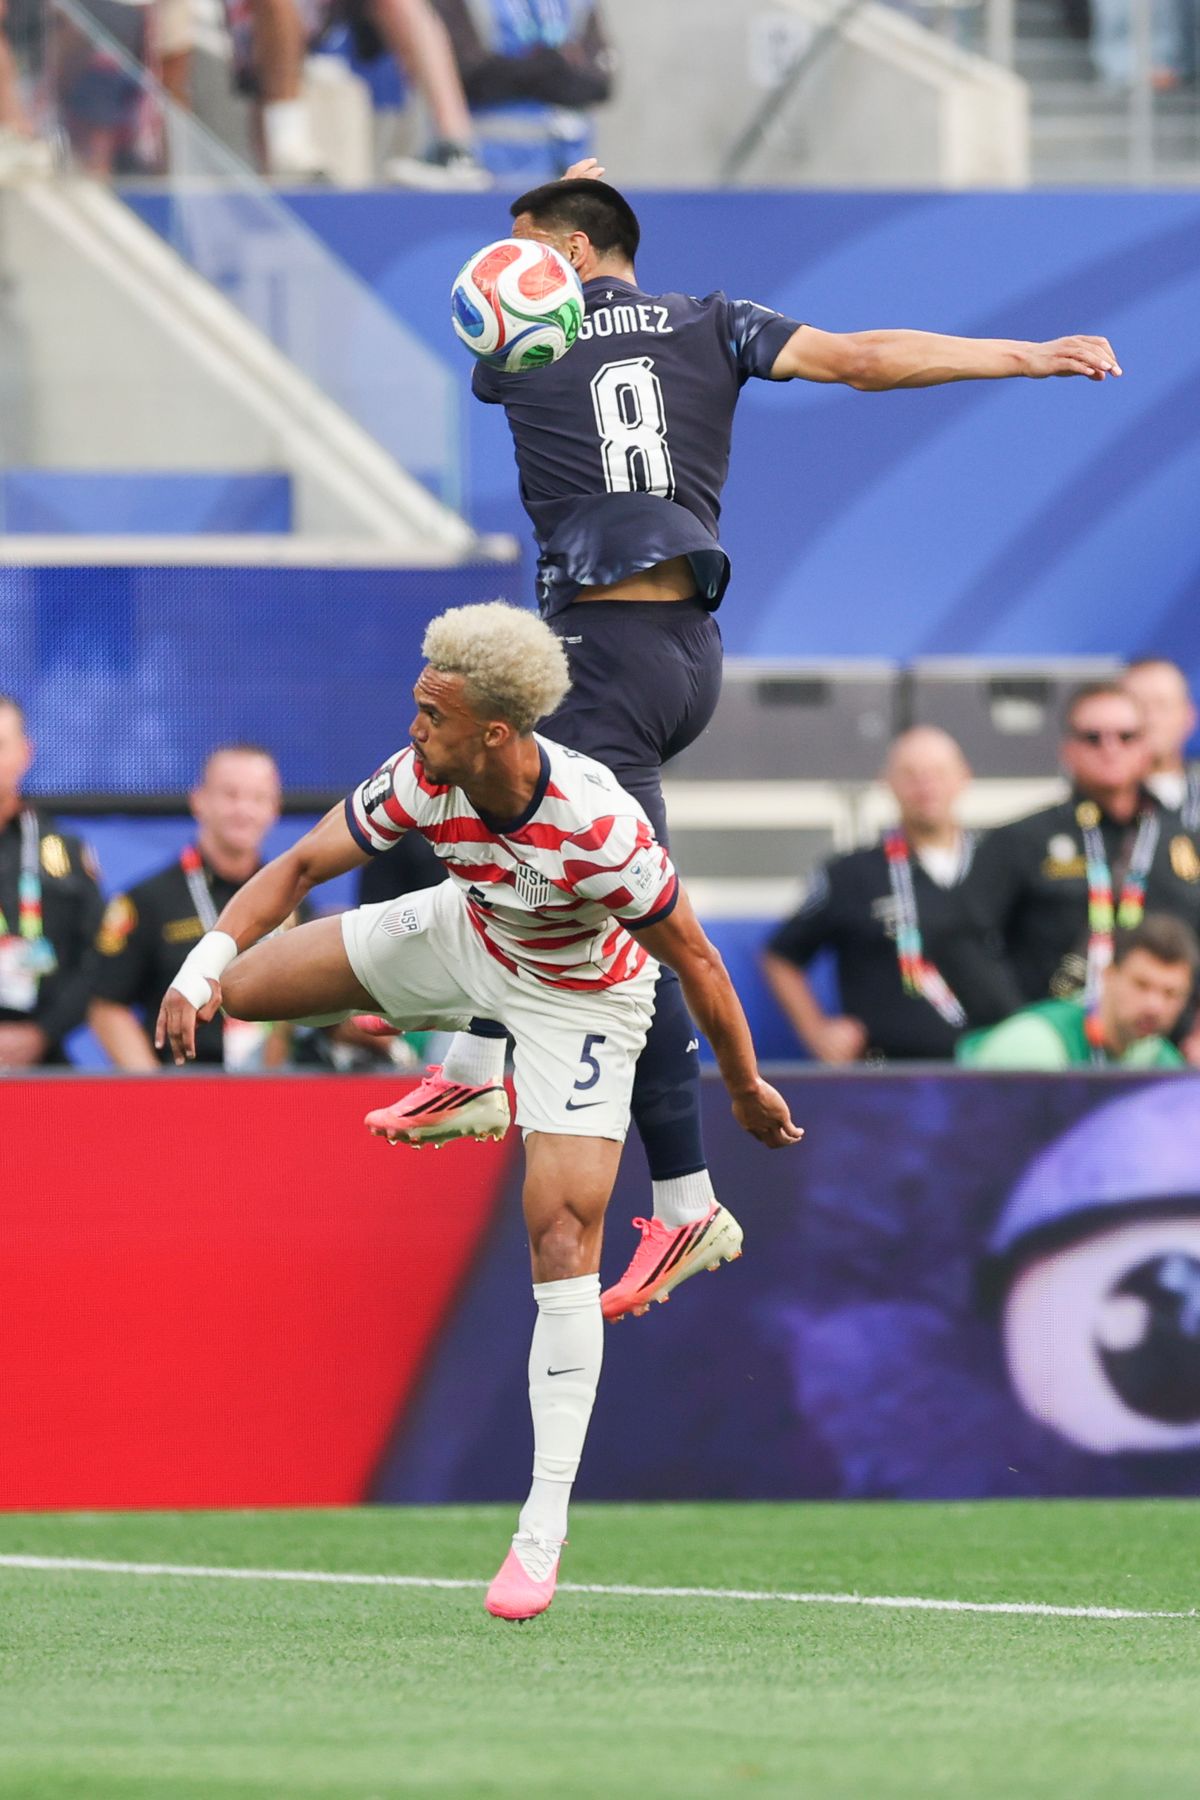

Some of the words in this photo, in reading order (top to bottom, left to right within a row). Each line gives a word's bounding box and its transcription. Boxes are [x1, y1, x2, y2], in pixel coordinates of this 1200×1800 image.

[577, 304, 674, 340] GOMEZ
[589, 356, 676, 501] 8
[519, 865, 549, 886] USA
[401, 909, 418, 931] USA
[573, 1033, 607, 1091] 5
